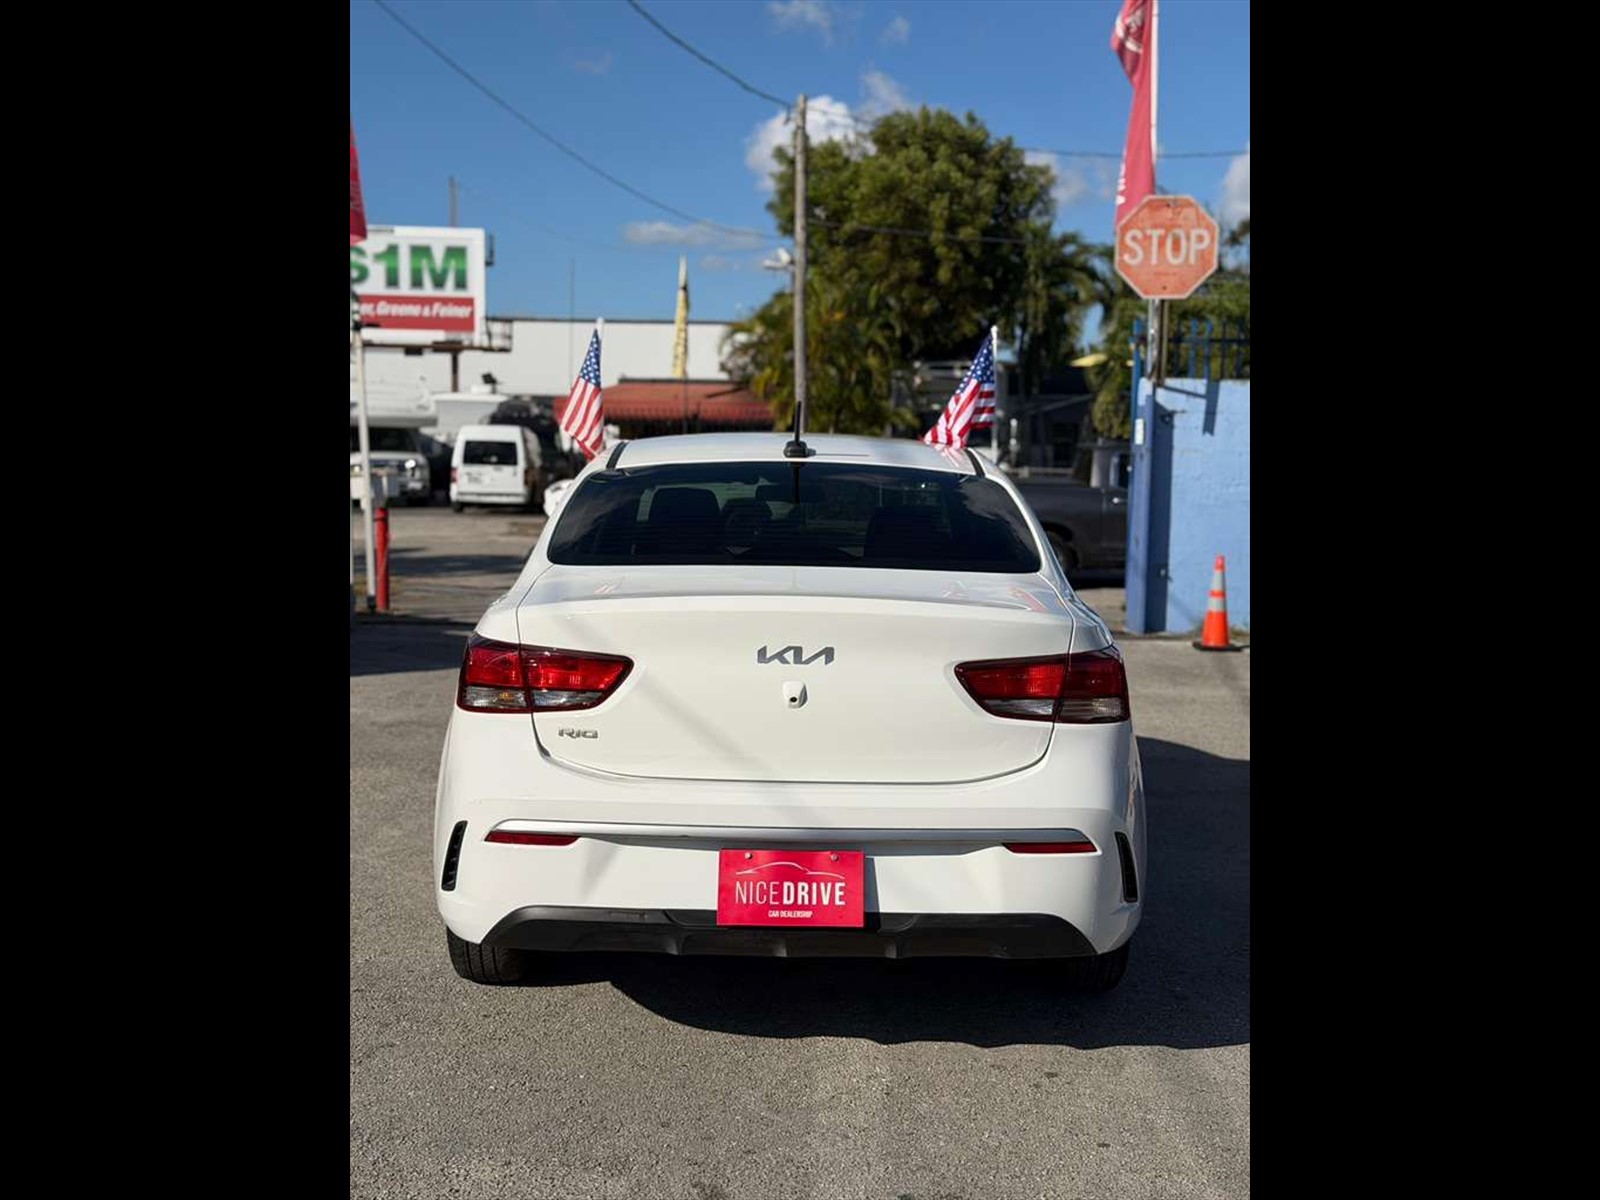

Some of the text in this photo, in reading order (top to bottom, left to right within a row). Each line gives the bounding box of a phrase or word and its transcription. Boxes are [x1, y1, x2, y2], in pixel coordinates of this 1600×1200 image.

[1123, 228, 1211, 265] STOP
[376, 301, 421, 317] Greene
[757, 645, 834, 665] KIA
[558, 727, 598, 739] RIO
[768, 910, 812, 918] CAR DEALERSHIP
